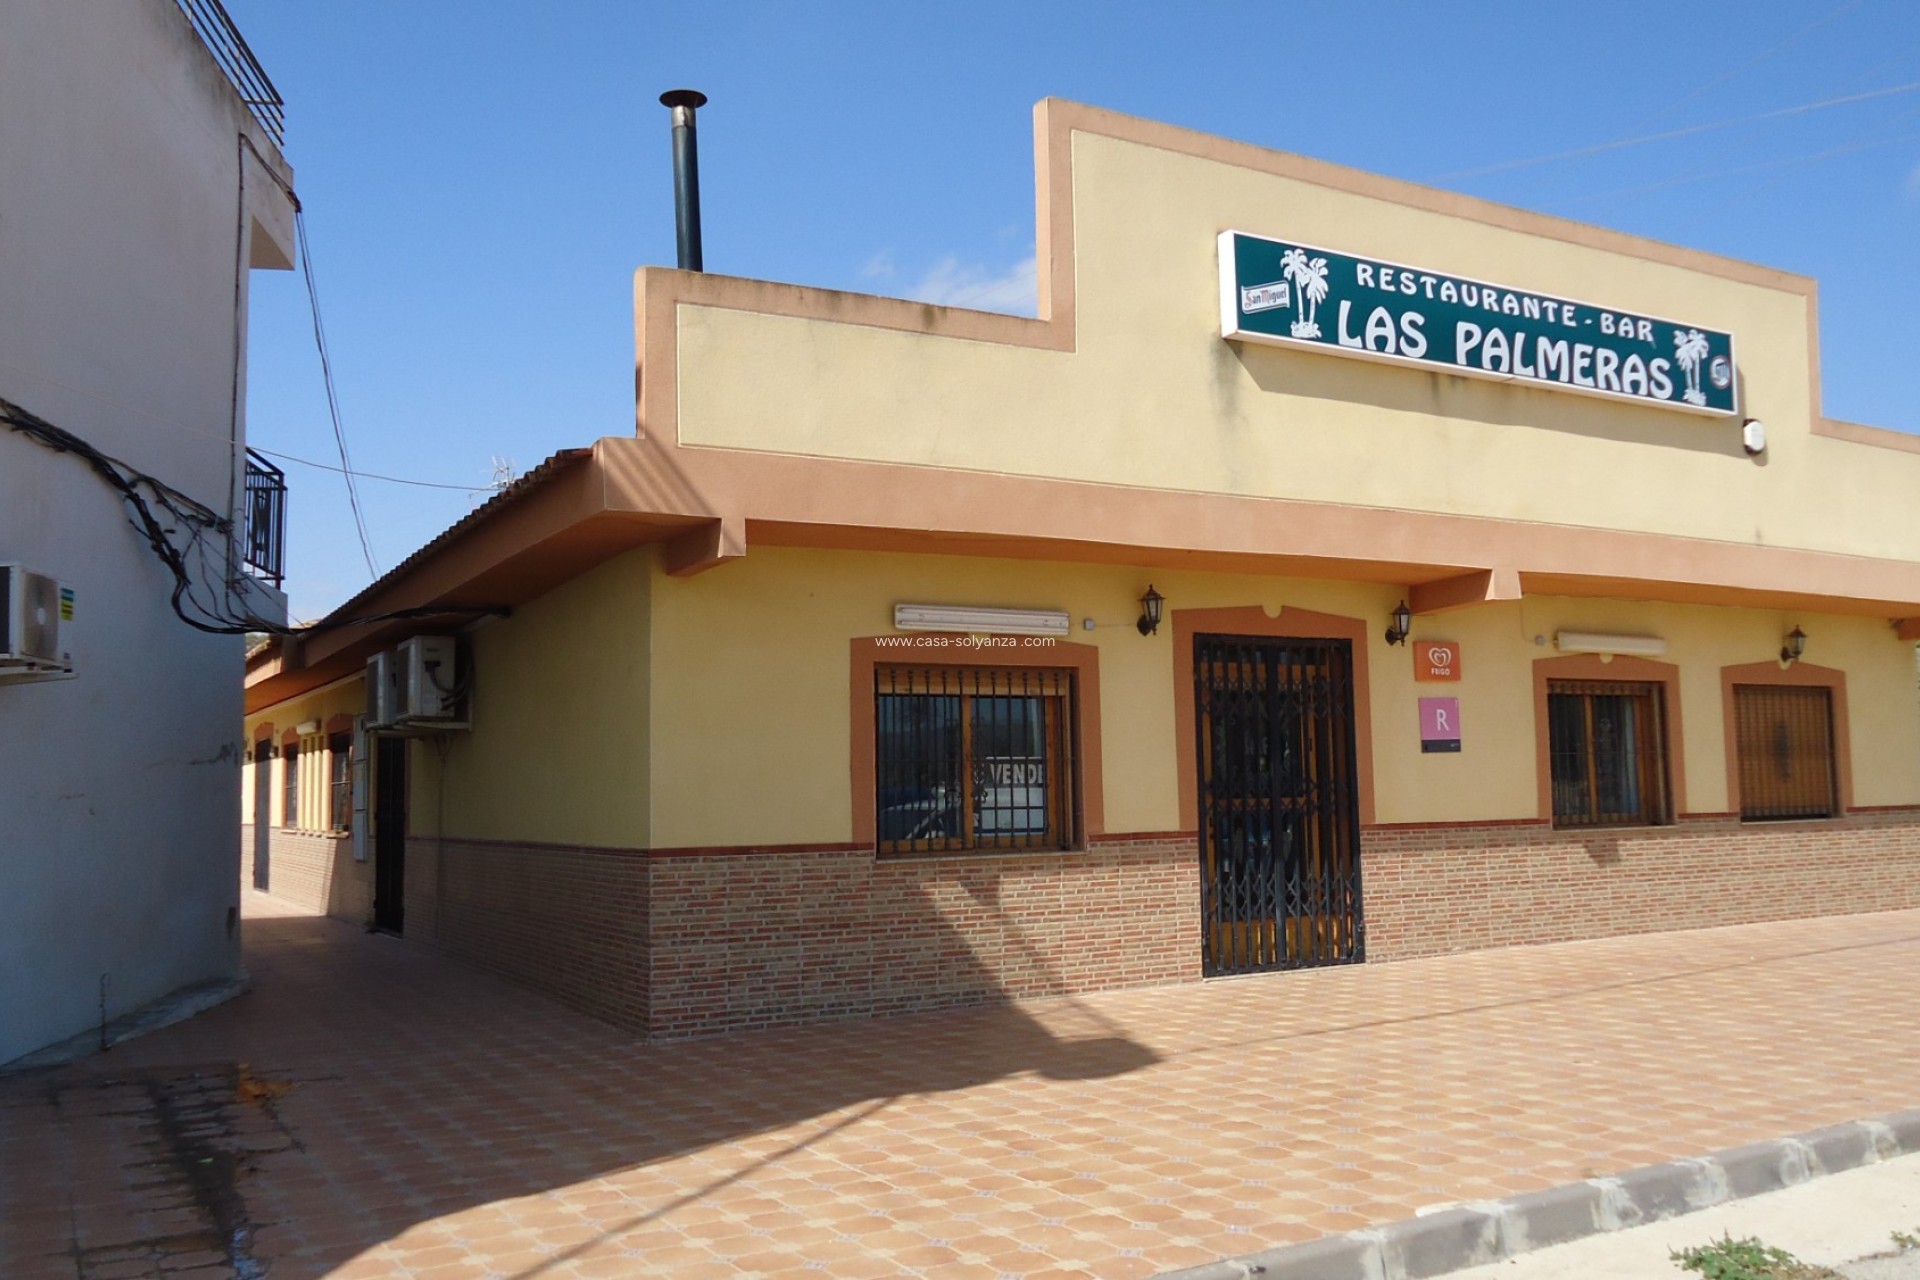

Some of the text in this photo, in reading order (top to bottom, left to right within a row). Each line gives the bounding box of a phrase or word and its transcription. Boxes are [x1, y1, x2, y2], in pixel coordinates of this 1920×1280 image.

[1244, 287, 1287, 308] San Miguel
[1356, 263, 1577, 327] RESTAURANTE
[1600, 312, 1654, 342] BAR
[1337, 300, 1428, 358] LAS
[1456, 321, 1674, 400] PALMERAS
[1436, 708, 1450, 731] R
